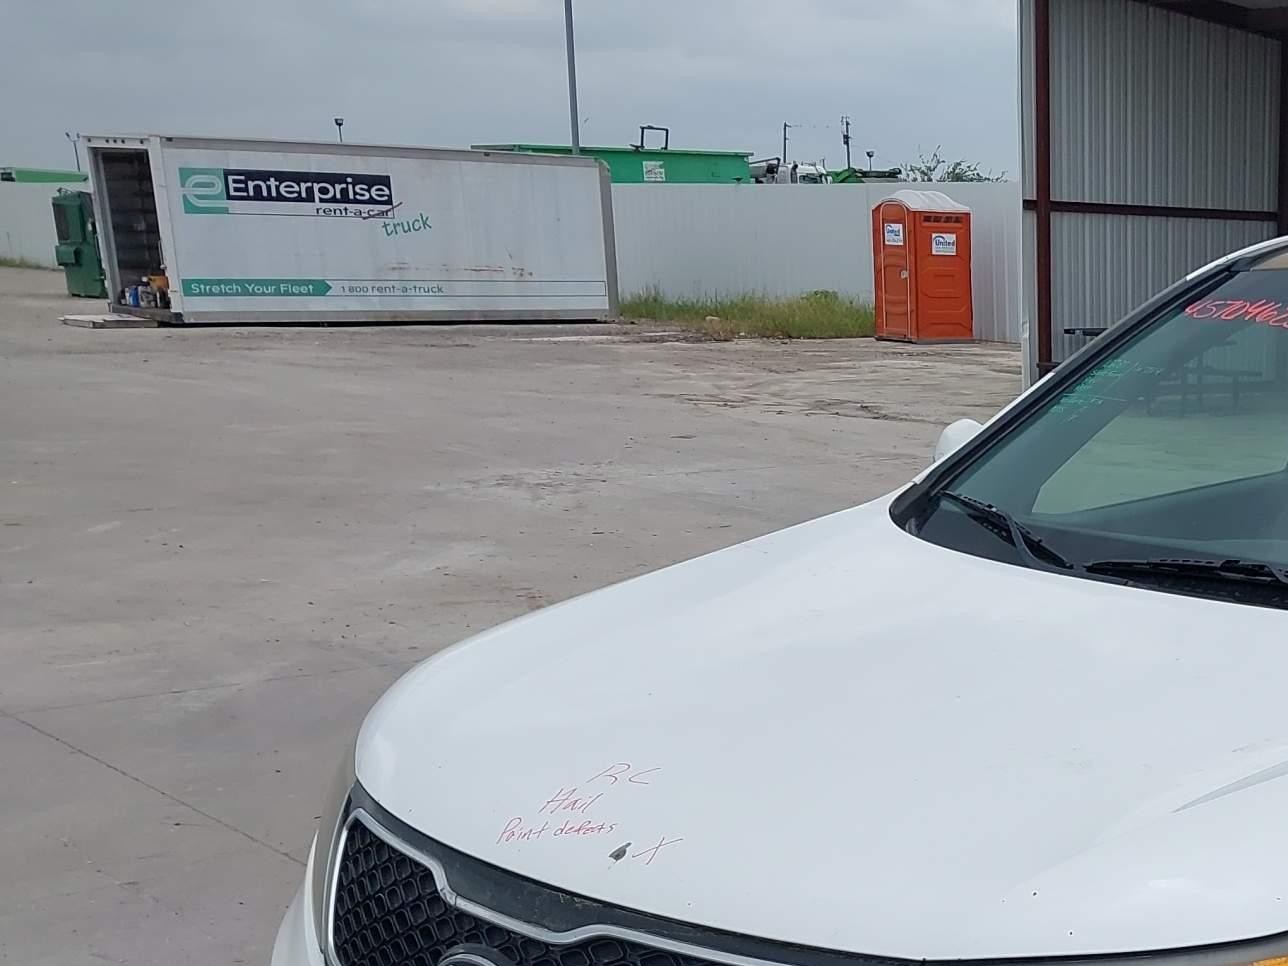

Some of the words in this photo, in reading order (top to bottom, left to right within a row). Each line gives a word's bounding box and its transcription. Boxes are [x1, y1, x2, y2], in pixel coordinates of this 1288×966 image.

[227, 175, 390, 203] Enterprise
[316, 205, 392, 218] rent-a-car
[382, 213, 432, 237] truck
[935, 239, 955, 247] United
[191, 283, 243, 295] Stretch
[245, 283, 278, 295] Your
[280, 283, 313, 295] Fleet
[371, 284, 444, 295] rent-a-truck
